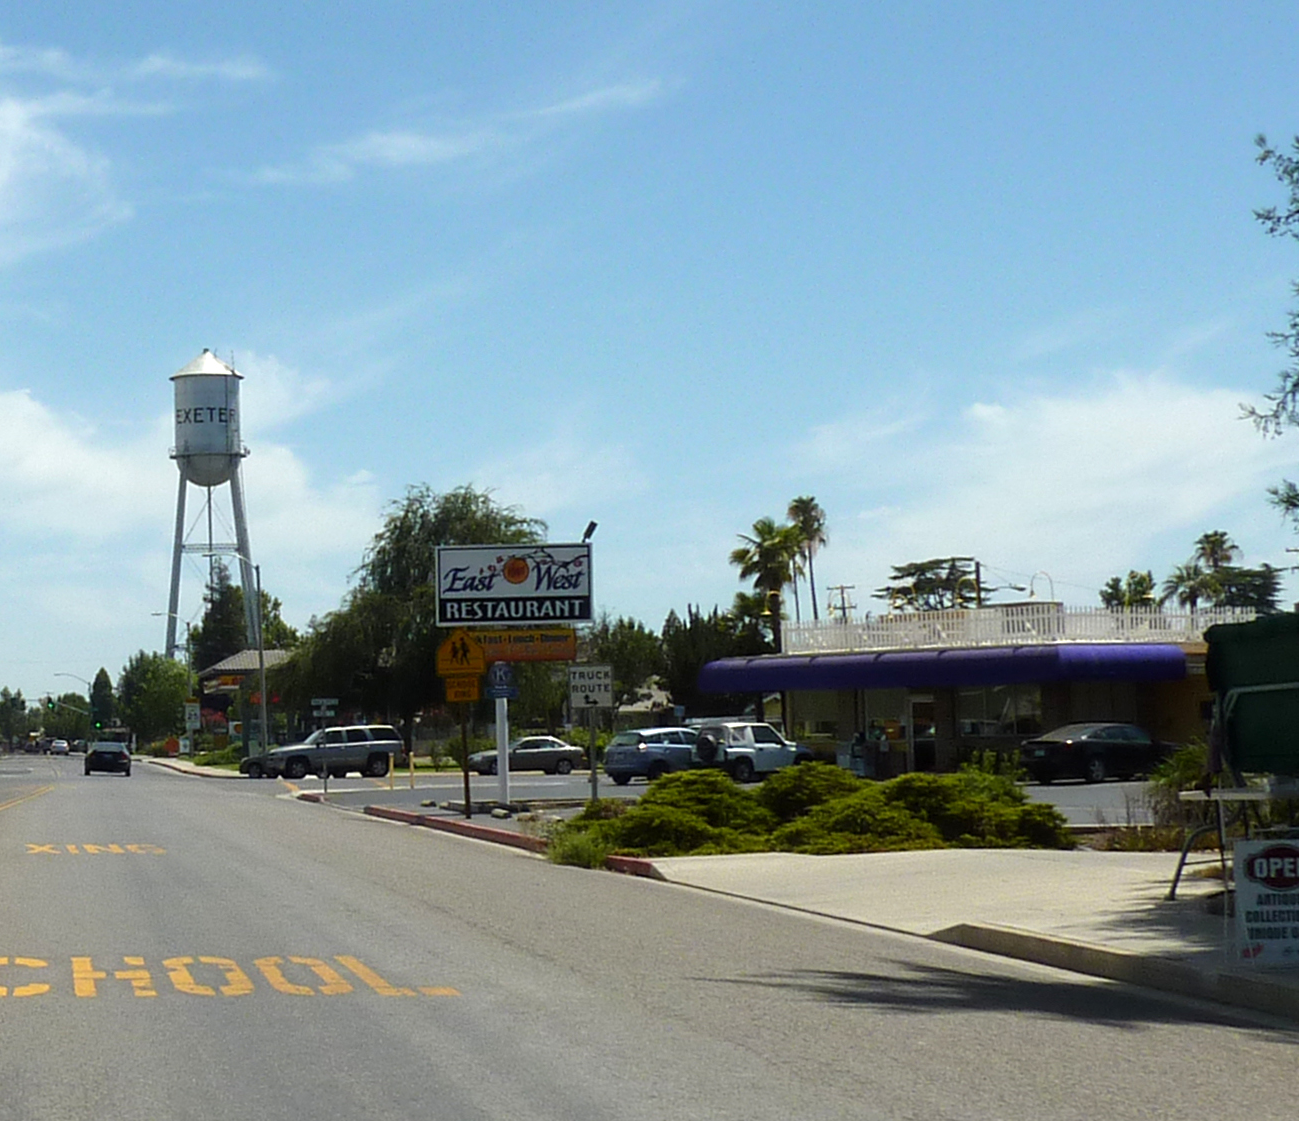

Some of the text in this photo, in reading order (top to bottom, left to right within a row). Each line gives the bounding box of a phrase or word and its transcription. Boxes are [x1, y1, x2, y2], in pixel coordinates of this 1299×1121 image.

[175, 407, 236, 424] EXETER
[443, 562, 585, 594] East West
[446, 600, 584, 620] RESTAURANT
[571, 671, 610, 681] TRUCK
[571, 684, 610, 693] ROUTE
[25, 843, 166, 856] XING
[1254, 857, 1299, 879] OPE
[1256, 893, 1299, 905] ANTIQU
